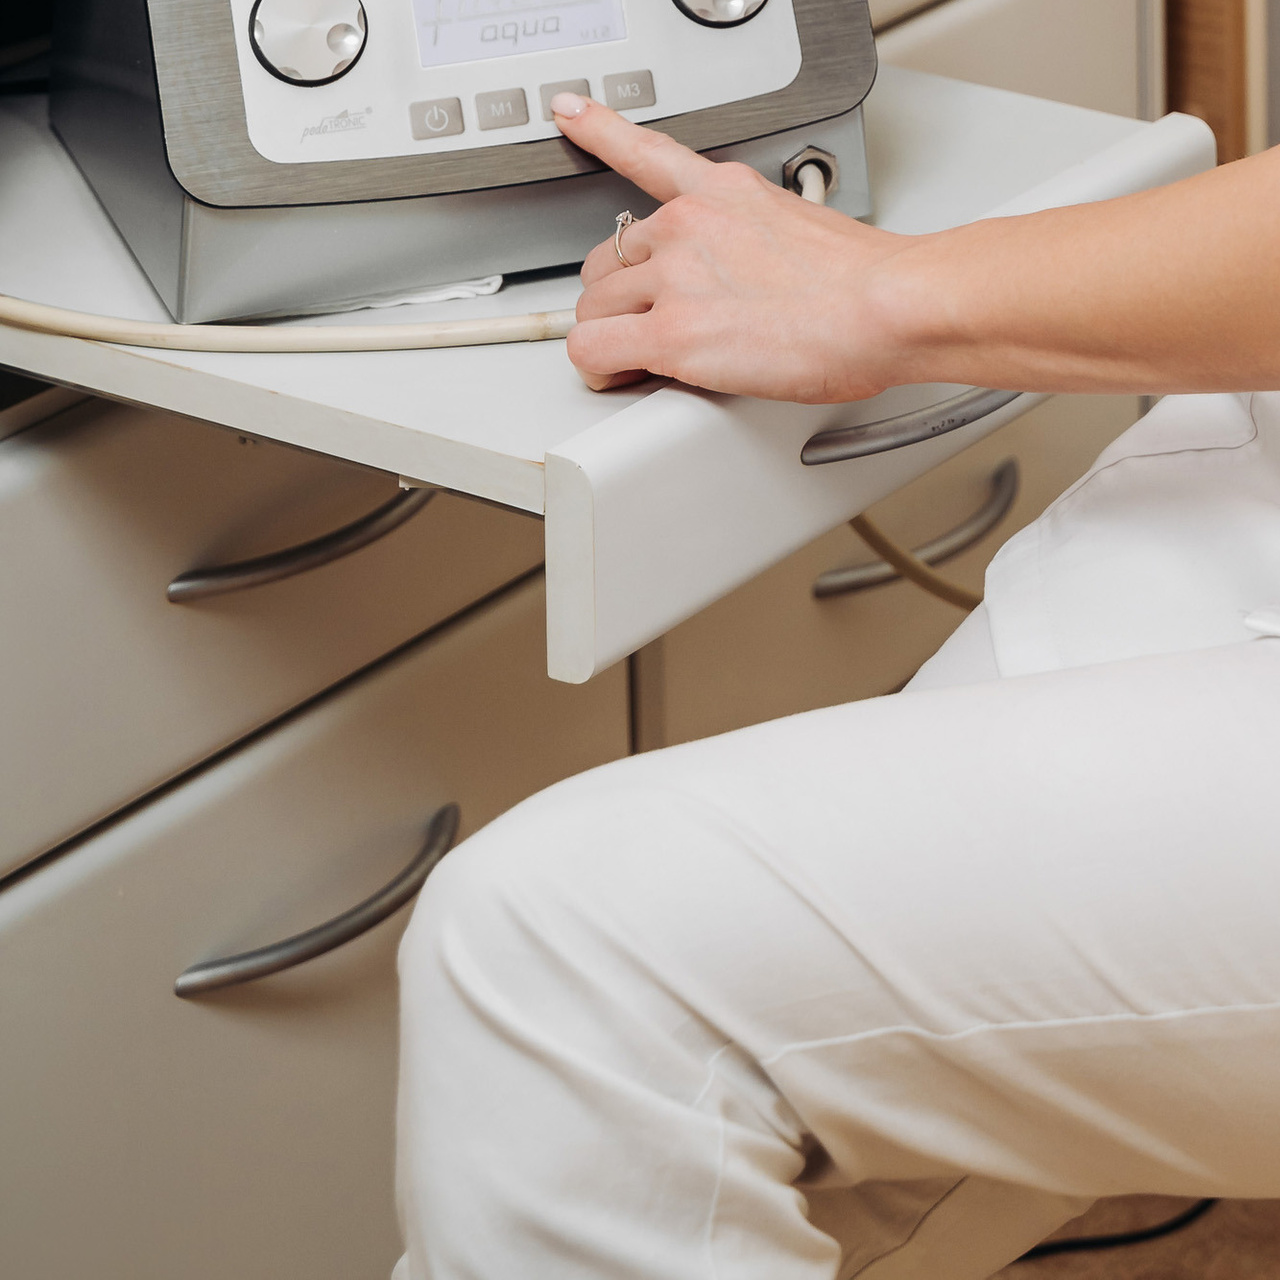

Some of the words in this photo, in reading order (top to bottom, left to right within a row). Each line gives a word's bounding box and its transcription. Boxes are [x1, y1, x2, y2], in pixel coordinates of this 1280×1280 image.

[480, 15, 561, 45] aqua
[617, 82, 640, 99] M3
[490, 101, 513, 117] M1
